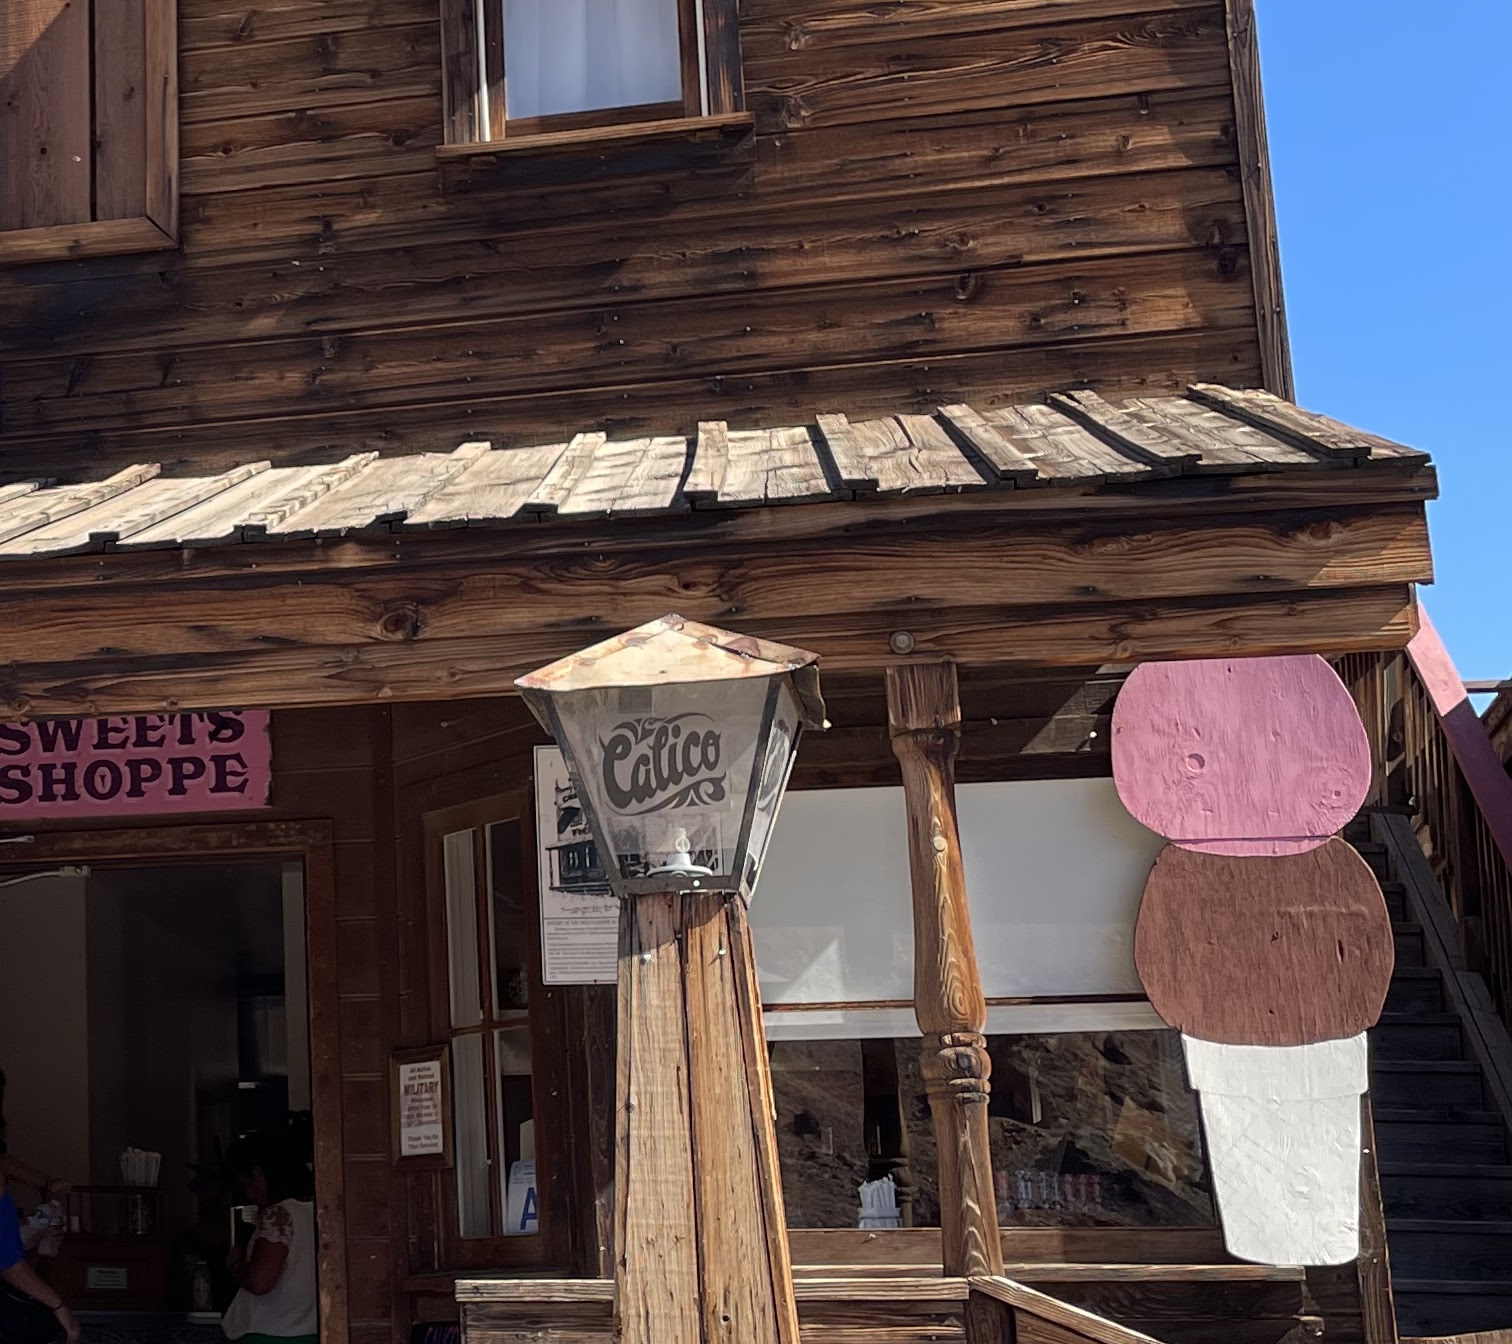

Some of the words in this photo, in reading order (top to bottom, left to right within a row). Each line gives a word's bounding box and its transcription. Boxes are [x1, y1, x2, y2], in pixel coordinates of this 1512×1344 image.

[598, 724, 722, 809] Calico
[404, 1081, 439, 1096] MILITARY
[520, 1188, 538, 1230] A
